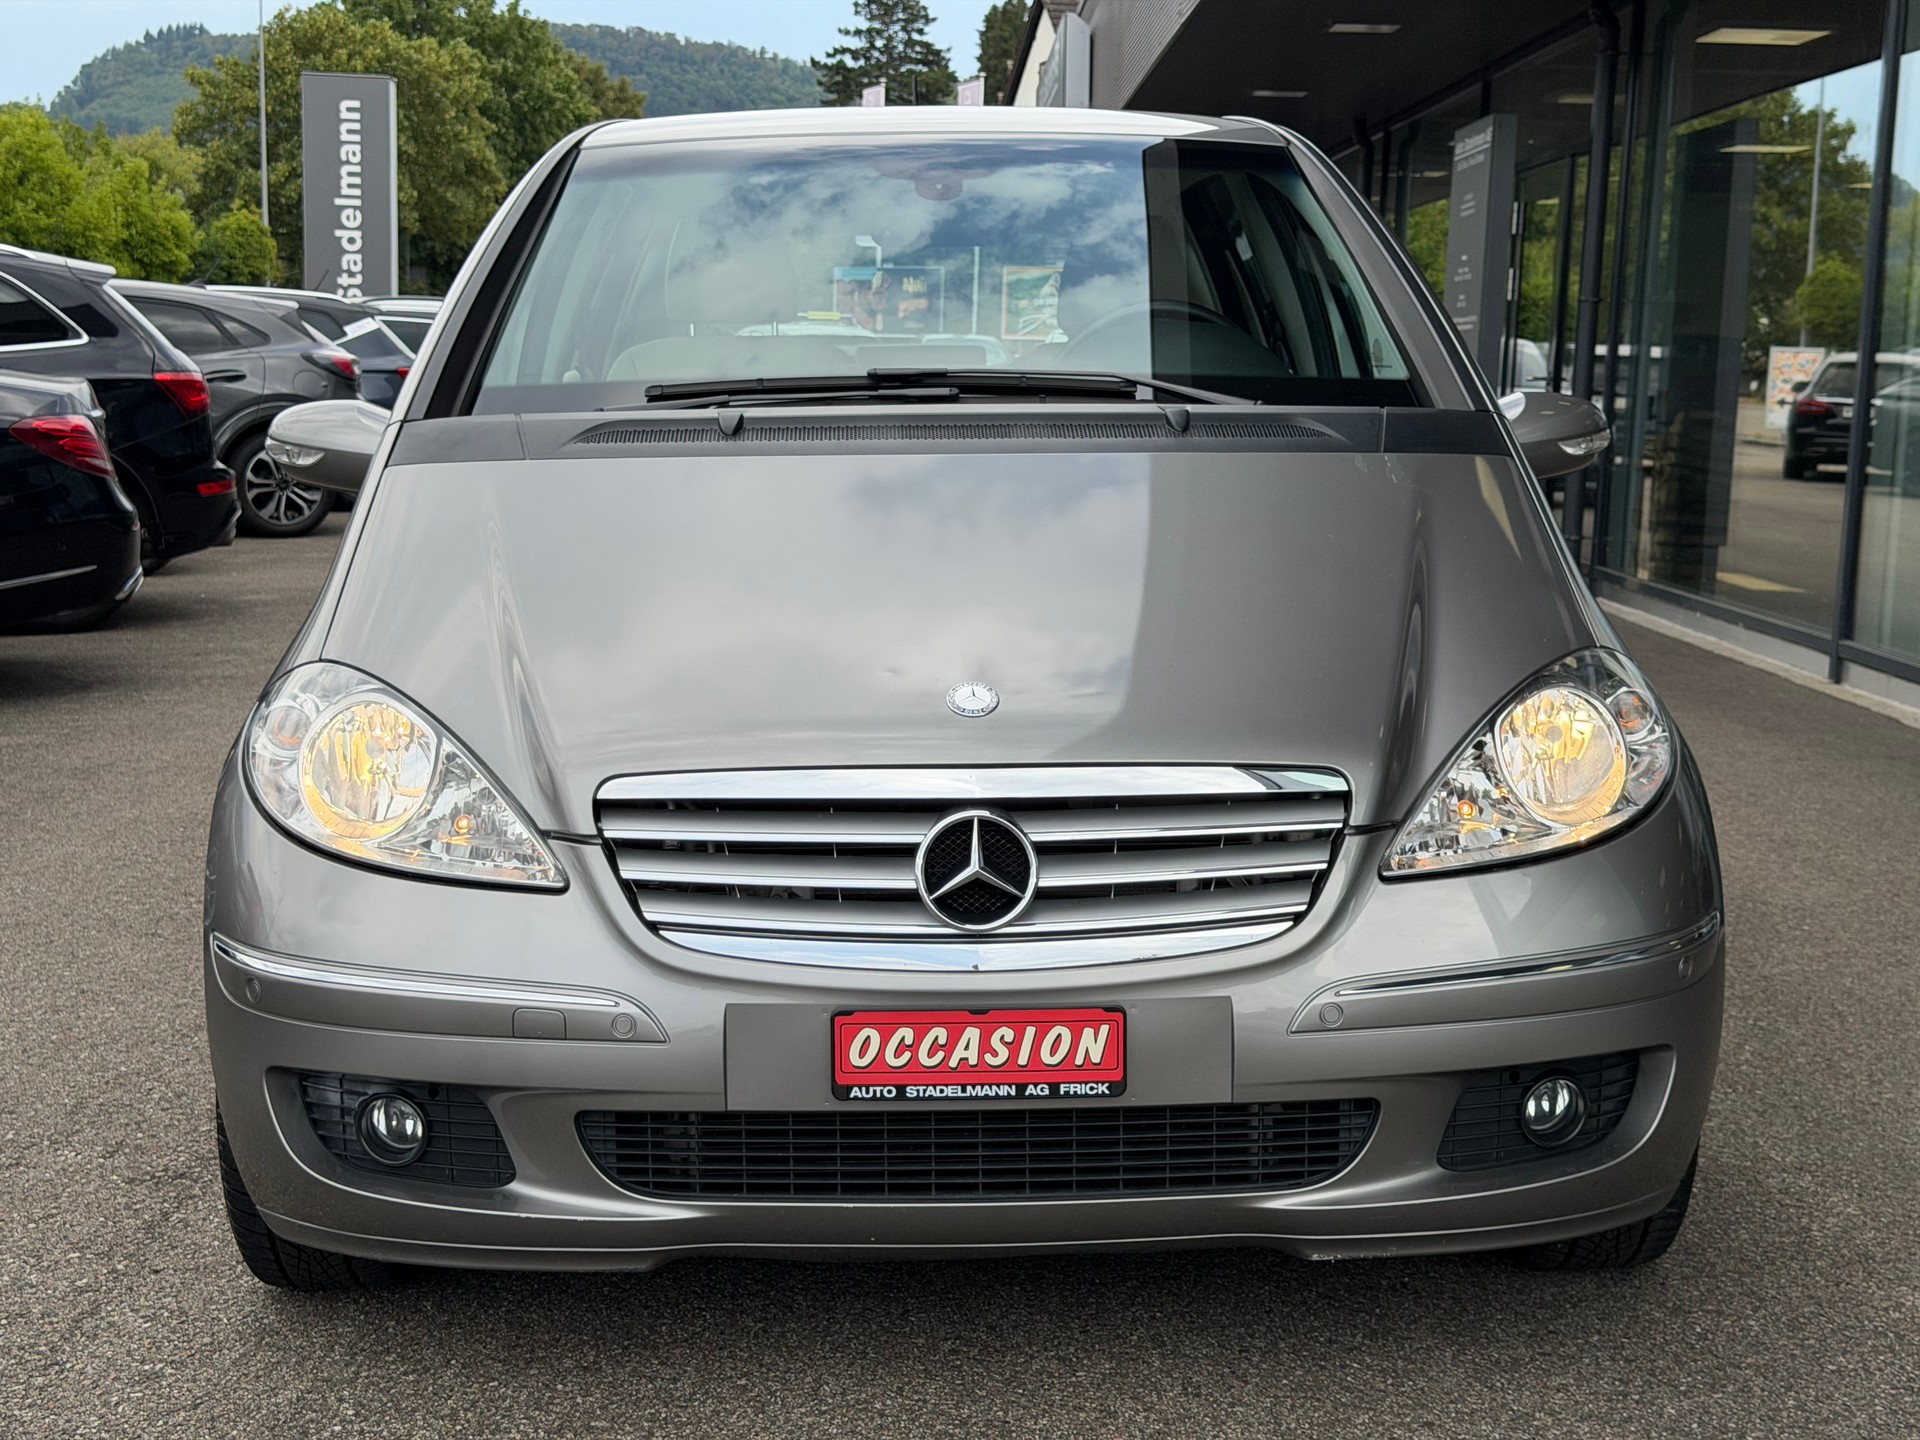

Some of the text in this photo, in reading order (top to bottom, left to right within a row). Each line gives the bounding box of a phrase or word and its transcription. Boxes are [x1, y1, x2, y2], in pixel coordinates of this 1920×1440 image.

[849, 1024, 1110, 1070] OCCASION
[849, 1083, 1110, 1098] AUTO STADELMANN AG FRICK
